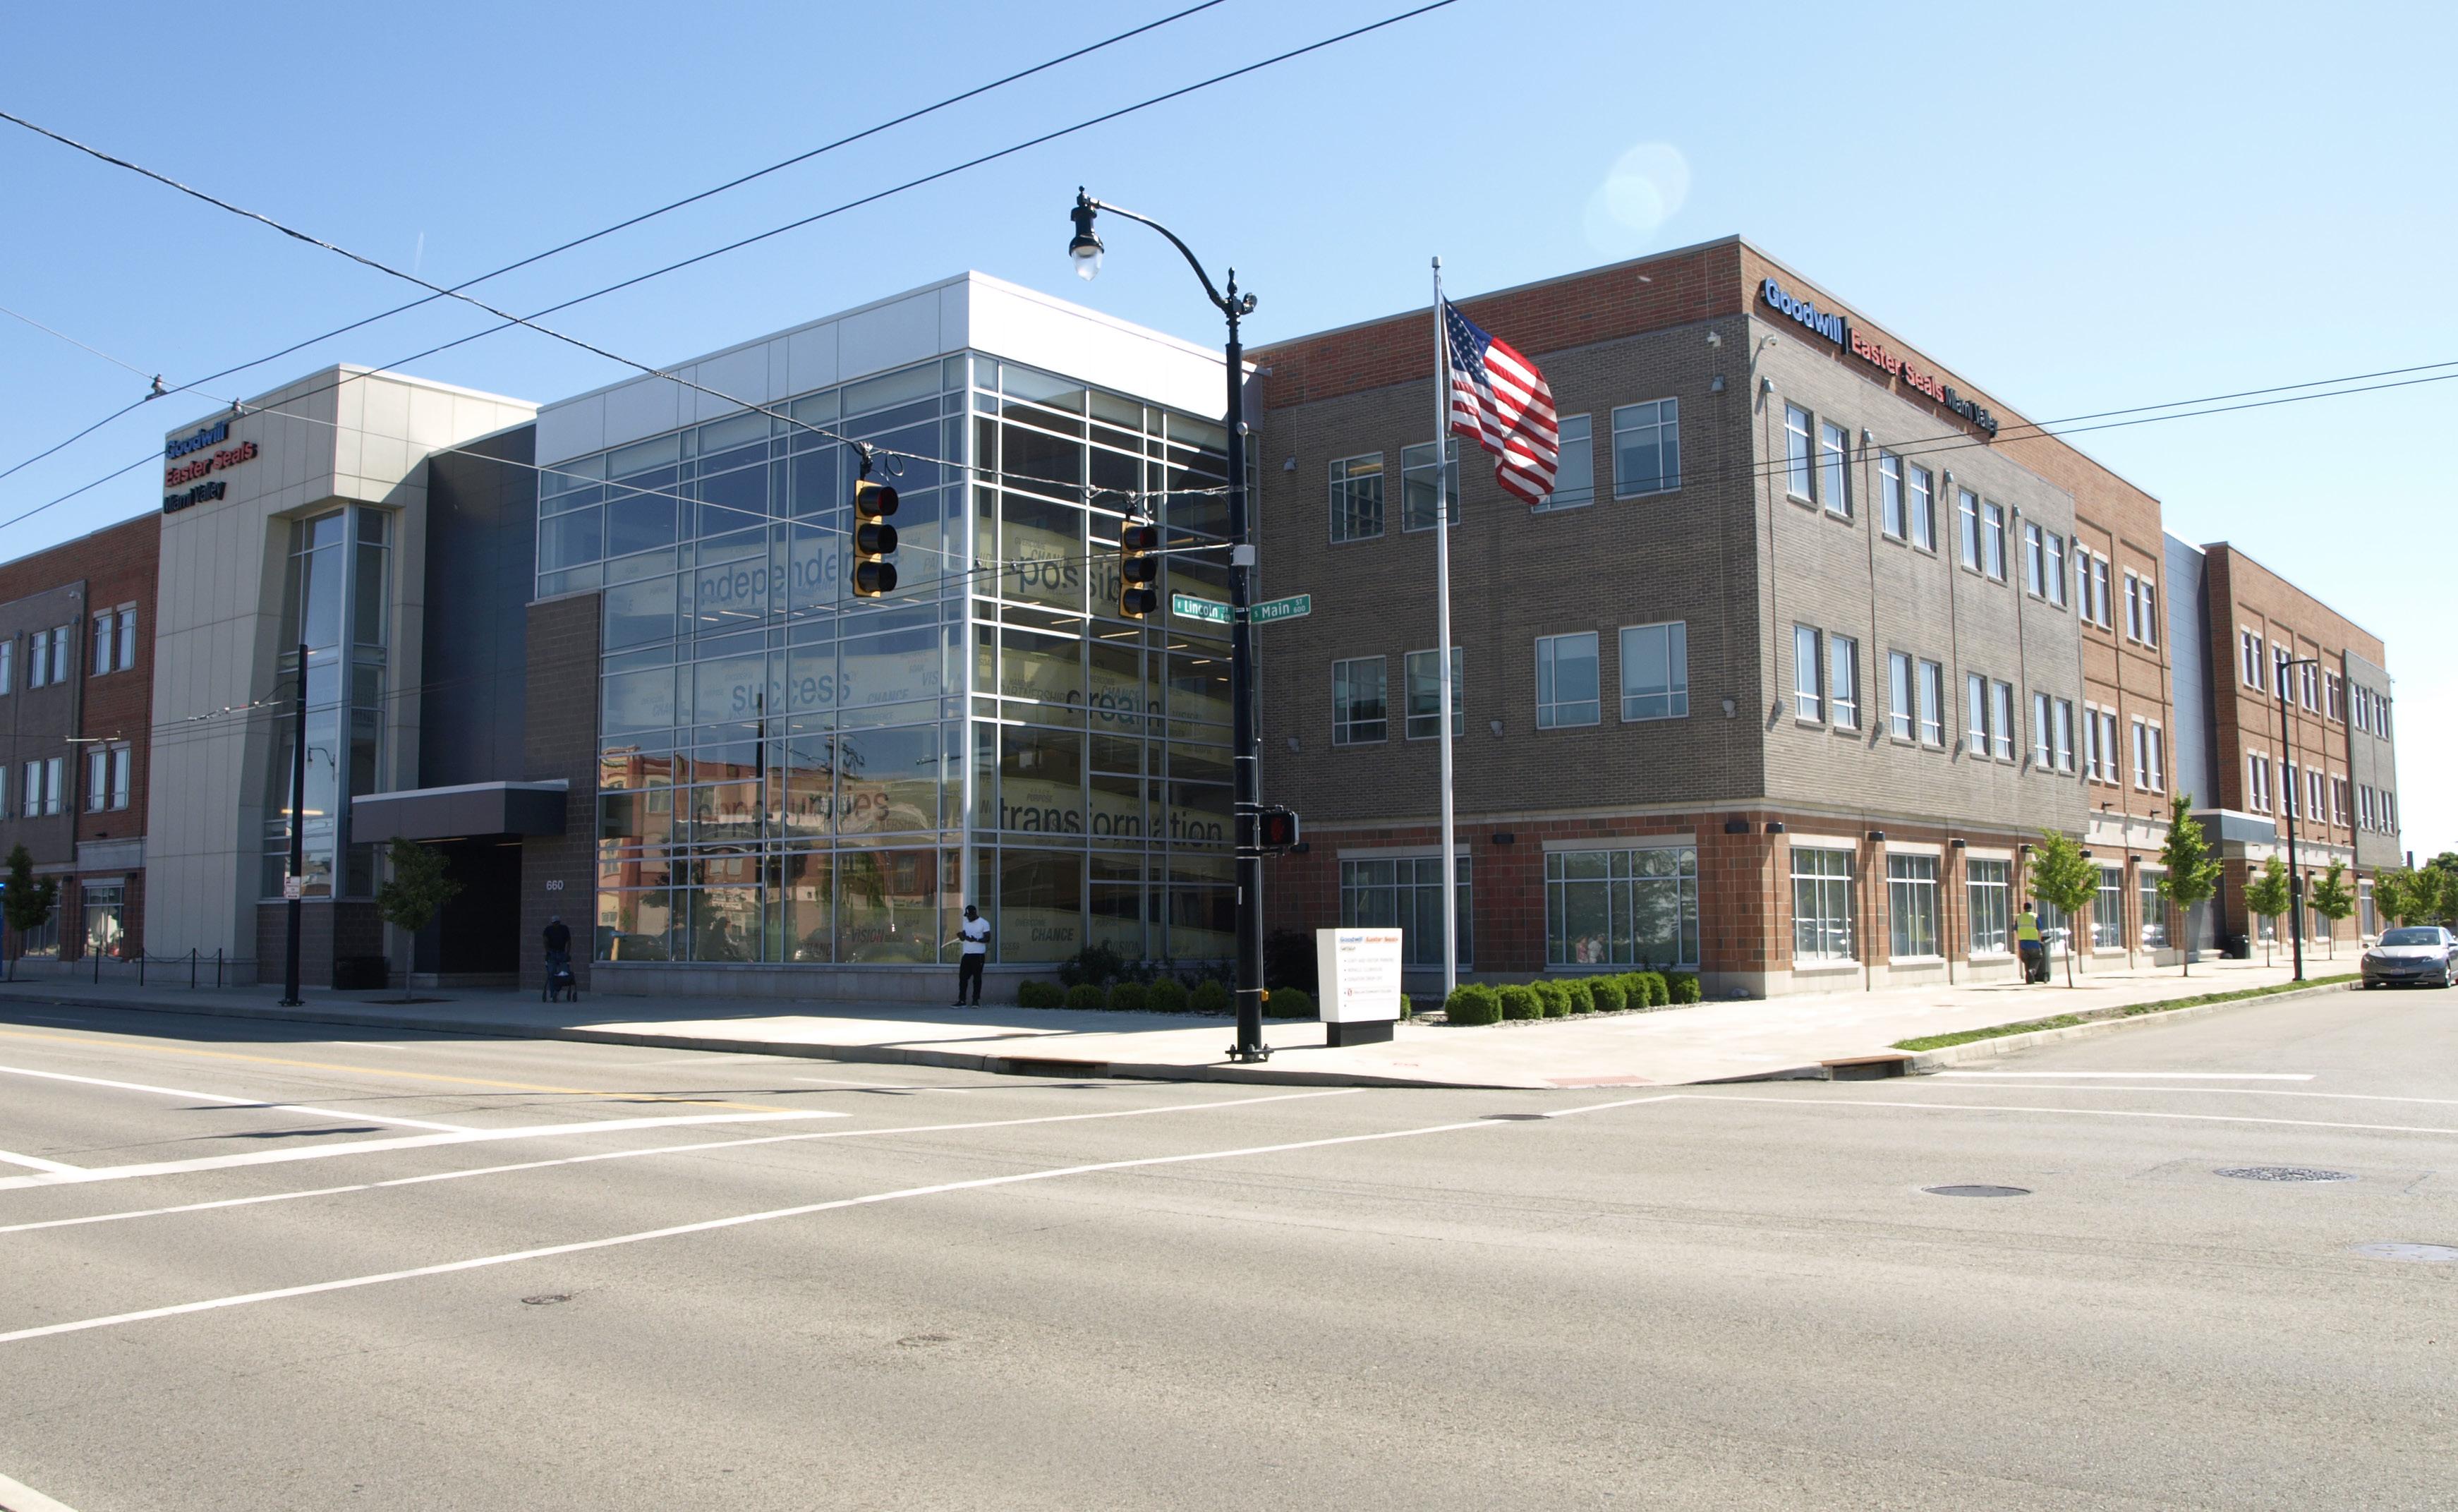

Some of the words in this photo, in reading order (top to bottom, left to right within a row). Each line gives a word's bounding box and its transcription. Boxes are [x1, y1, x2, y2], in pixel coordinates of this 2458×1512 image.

[1764, 277, 1843, 345] Goodwill
[1851, 327, 1901, 376] Easter
[1905, 361, 1944, 404] Seals
[166, 421, 228, 459] Goodwill
[165, 459, 211, 487] Easter
[213, 441, 258, 471] Seals
[1185, 600, 1218, 618] Lincoln
[1261, 603, 1290, 619] Main
[1000, 797, 1222, 849] transormtion
[546, 880, 564, 890] 660
